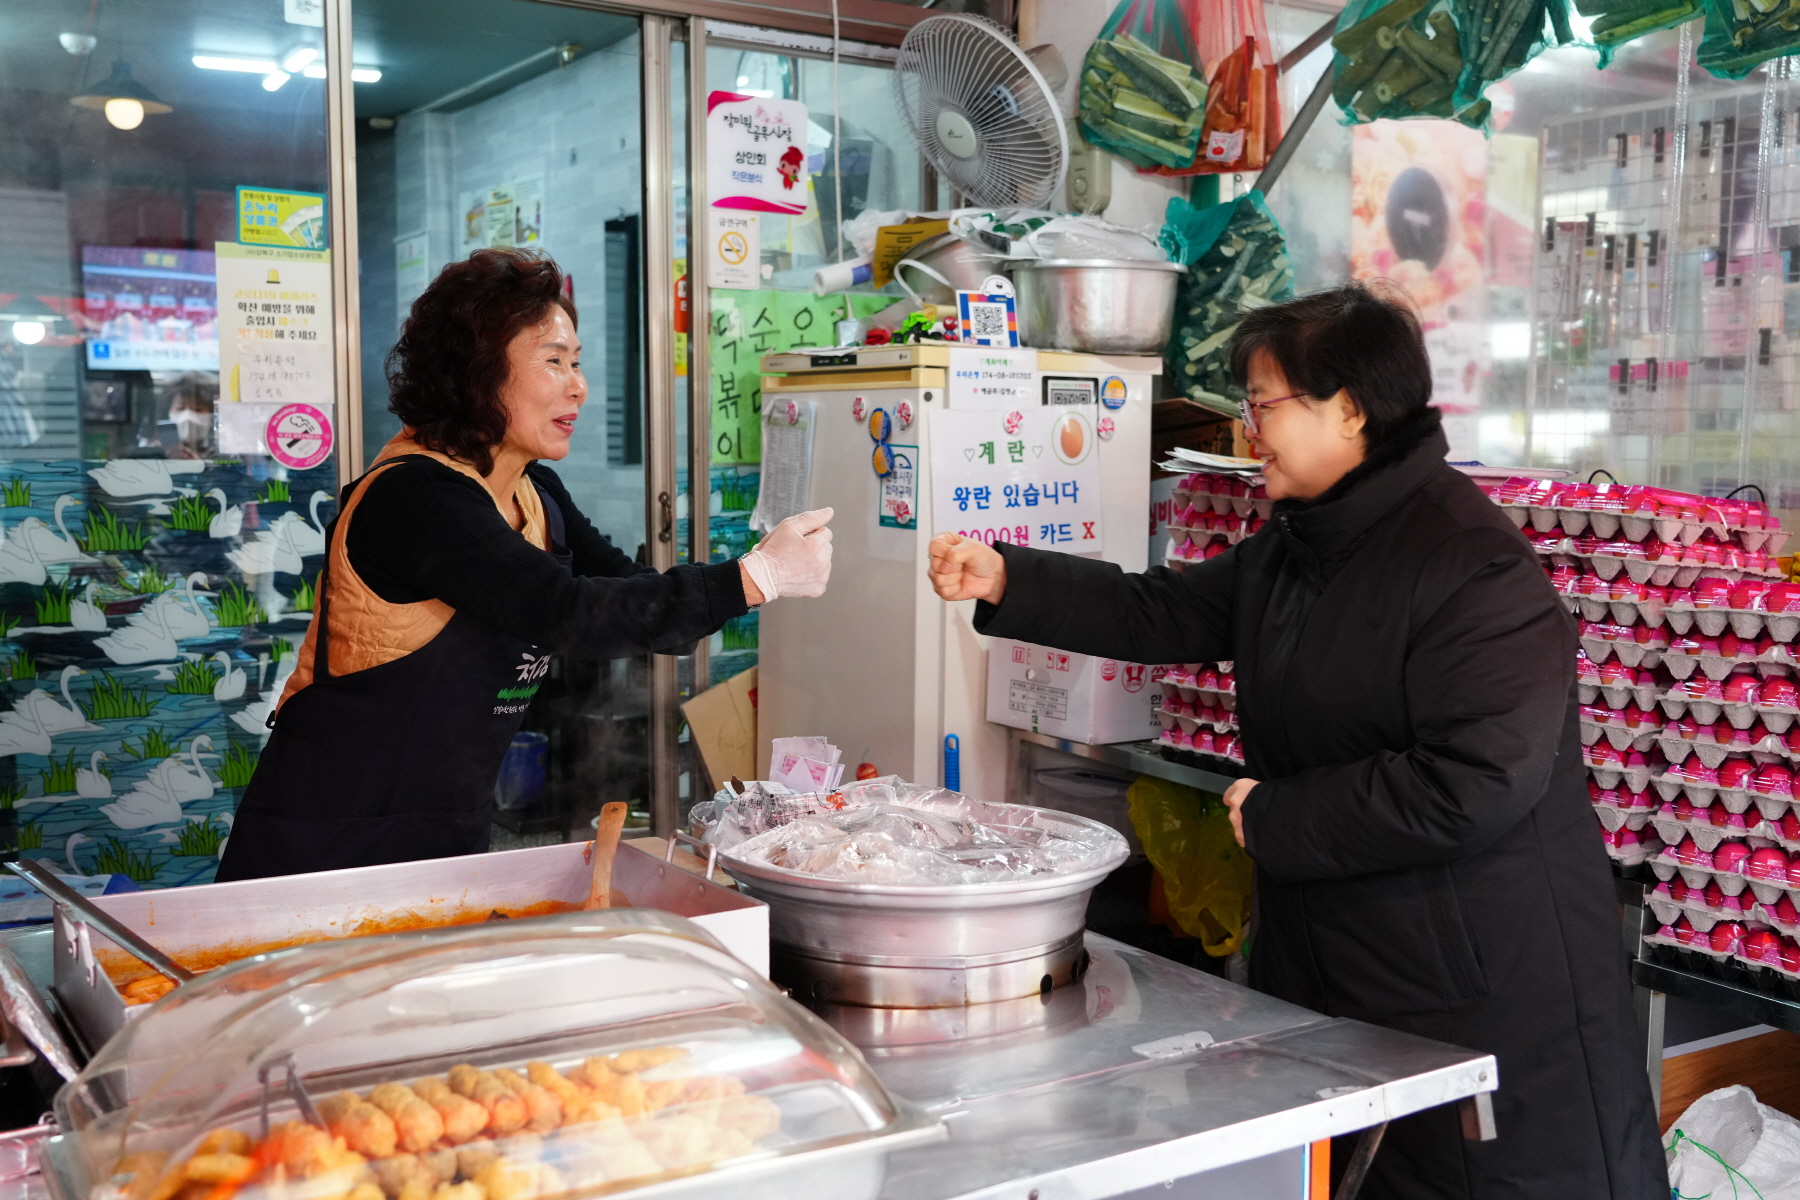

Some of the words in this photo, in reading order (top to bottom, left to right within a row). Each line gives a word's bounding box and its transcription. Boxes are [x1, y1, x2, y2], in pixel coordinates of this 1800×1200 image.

[723, 113, 752, 132] 장미원
[751, 125, 792, 142] 골목시장
[735, 151, 767, 166] 상인회
[731, 170, 764, 184] 작은분식
[243, 200, 278, 214] 온누리
[243, 214, 278, 227] 상품권
[719, 217, 748, 229] 금연구역
[234, 289, 277, 300] 코로나19
[279, 291, 318, 301] 바이러스
[237, 302, 258, 312] 확산
[261, 303, 292, 314] 예방을
[295, 304, 316, 315] 위해
[246, 315, 276, 326] 출입시
[288, 330, 317, 340] 주세요
[956, 371, 979, 379] 우리은행
[953, 486, 991, 511] 왕란
[1003, 480, 1079, 508] 있습니다
[1040, 523, 1073, 545] 카드
[1082, 521, 1096, 540] X
